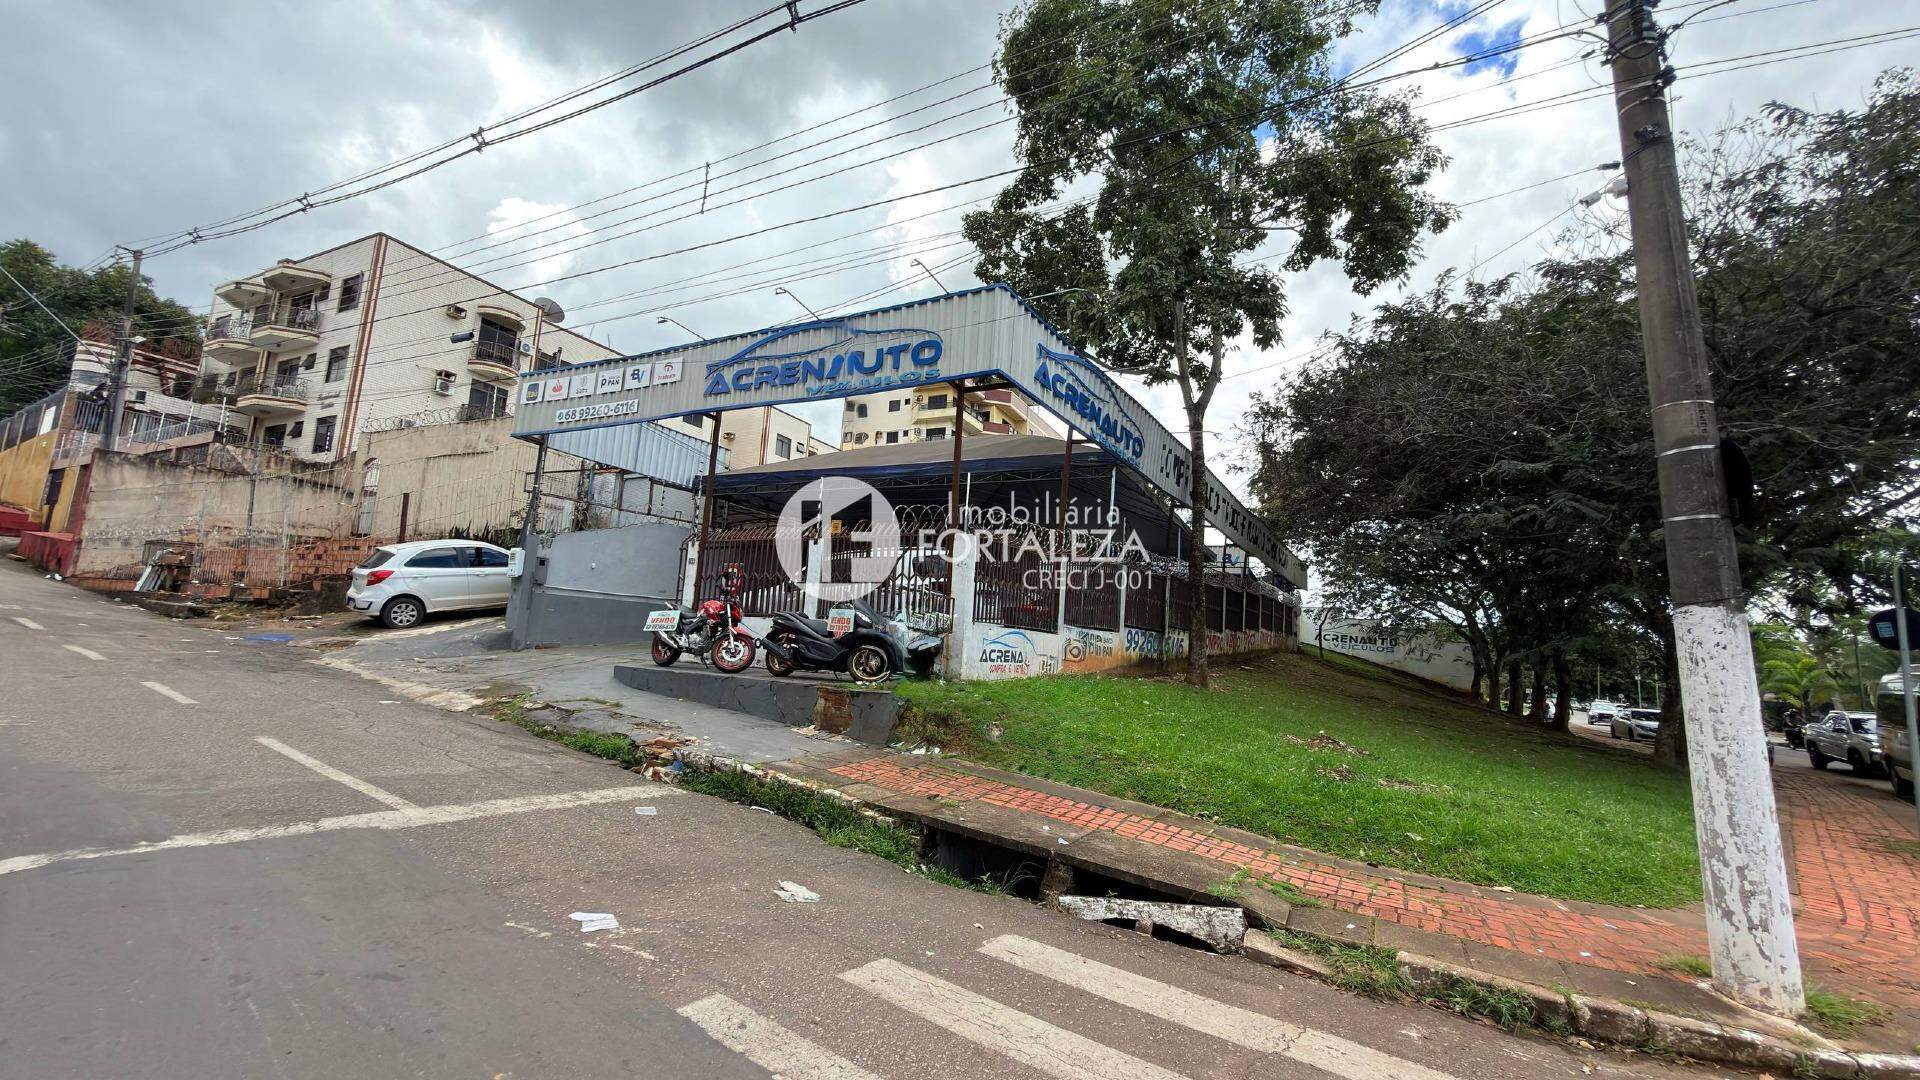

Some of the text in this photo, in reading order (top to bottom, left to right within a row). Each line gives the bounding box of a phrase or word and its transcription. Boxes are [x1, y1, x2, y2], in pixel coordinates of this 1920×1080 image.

[565, 400, 636, 421] 68 99260-6116
[1034, 361, 1143, 459] ACRENAUTO
